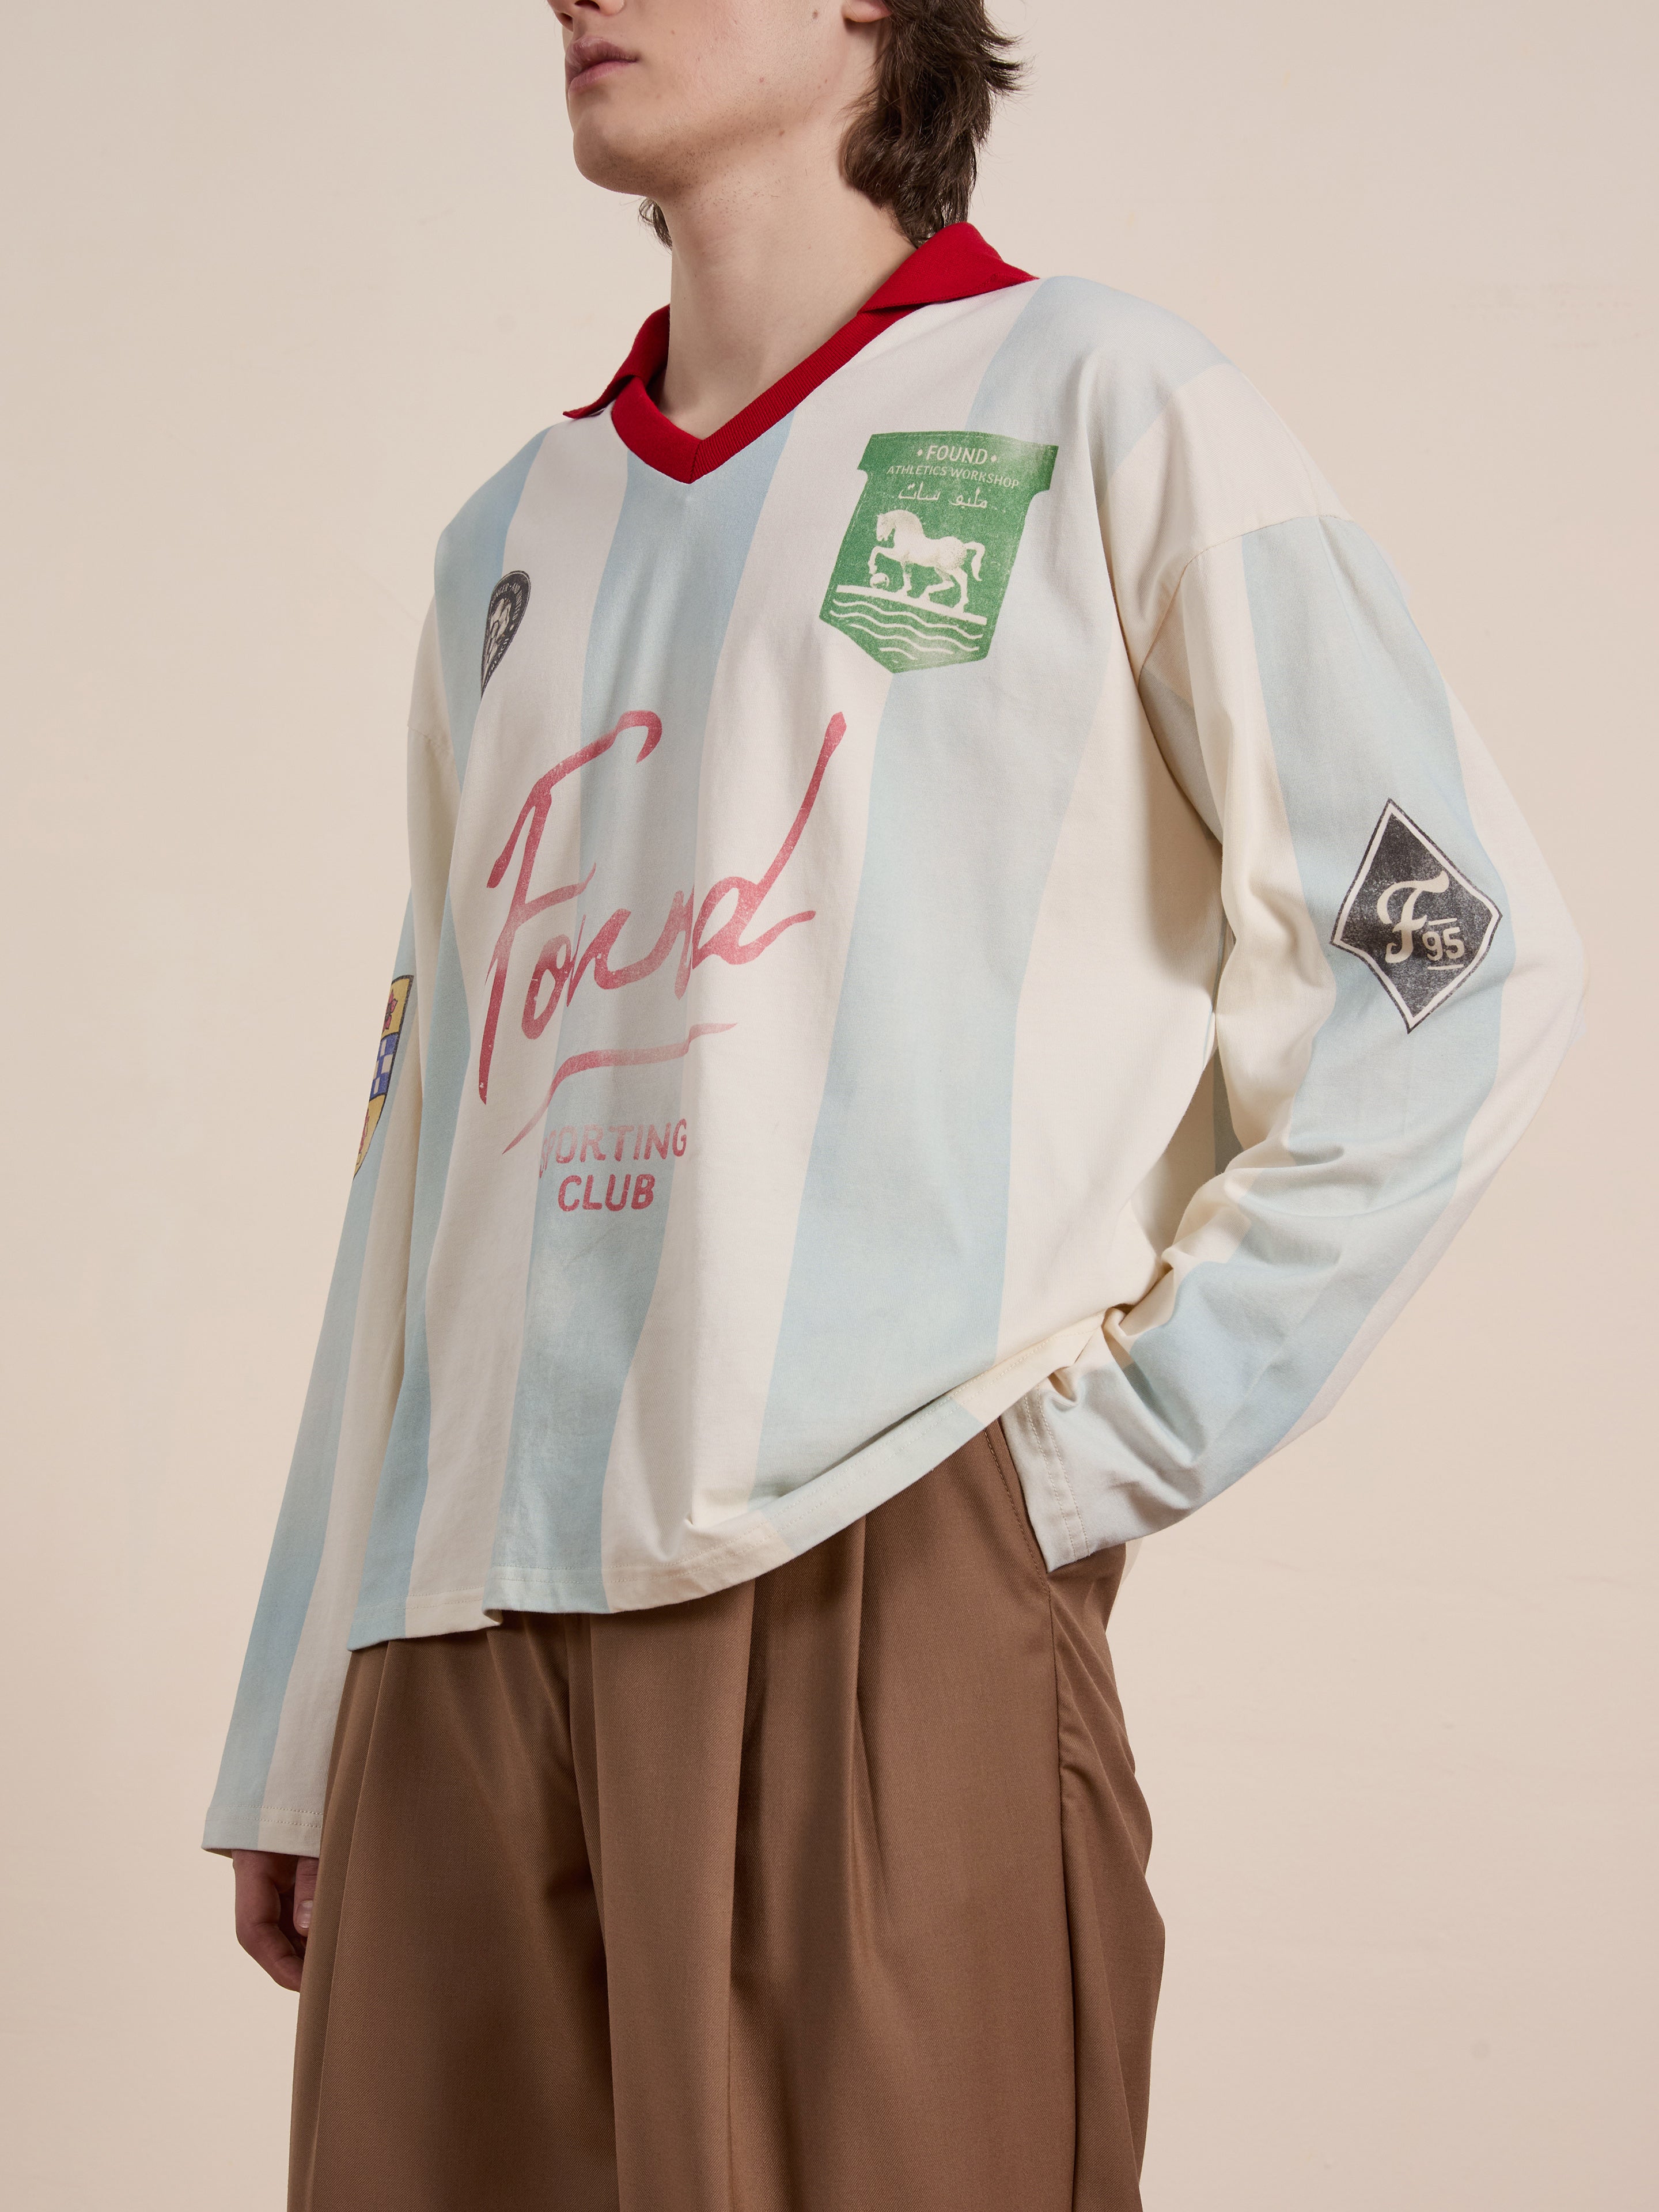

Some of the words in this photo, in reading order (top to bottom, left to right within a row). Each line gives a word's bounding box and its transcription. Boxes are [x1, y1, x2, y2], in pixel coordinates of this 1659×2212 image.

[926, 445, 988, 465] FOUND
[887, 465, 947, 476] ATHLETICS
[950, 468, 1019, 488] WORKSHOP
[1422, 927, 1465, 962] 95
[558, 1173, 656, 1212] CLUB
